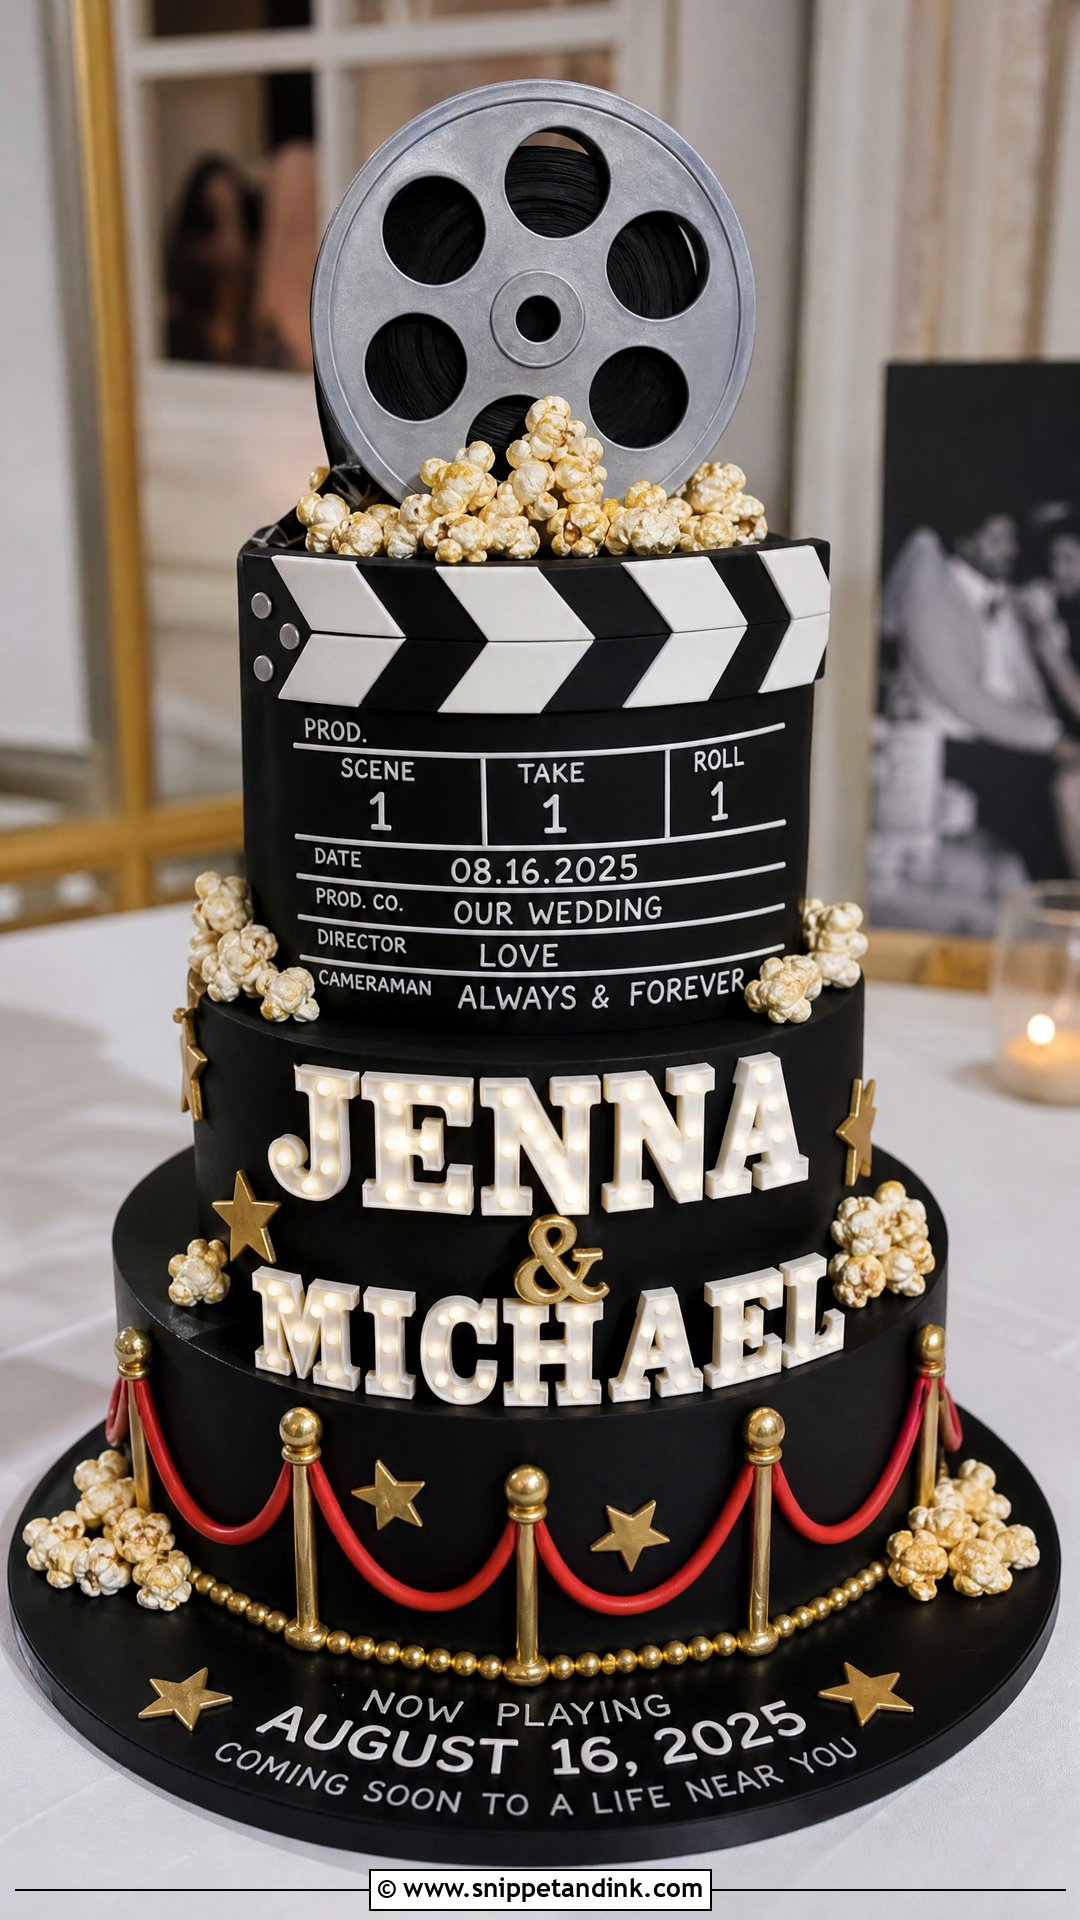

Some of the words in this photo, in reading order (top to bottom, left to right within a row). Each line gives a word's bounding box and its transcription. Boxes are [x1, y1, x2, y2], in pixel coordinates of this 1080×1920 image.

[305, 718, 366, 743] PROD.
[341, 758, 415, 781] SCENE
[518, 762, 584, 783] TAKE
[695, 746, 744, 772] ROLL
[370, 792, 392, 831] 1
[543, 794, 567, 833] 1
[711, 781, 728, 821] 1
[315, 848, 361, 867] DATE
[451, 854, 637, 884] 08.16.2025
[316, 888, 366, 908] PROD.
[373, 894, 403, 911] CO.
[454, 901, 513, 925] OUR
[528, 896, 664, 926] WEDDING
[318, 929, 406, 953] DIRECTOR
[480, 944, 558, 967] LOVE
[319, 970, 431, 995] CAMERAMAN
[458, 985, 576, 1010] ALWAYS
[592, 985, 609, 1009] &
[629, 967, 744, 1006] FOREVER
[267, 1052, 809, 1216] JENNA
[514, 1214, 609, 1305] &
[253, 1253, 845, 1407] MICHAEL
[362, 1690, 464, 1723] NOW
[497, 1694, 670, 1726] PLAYING
[255, 1704, 519, 1776] AUGUST
[552, 1736, 637, 1777] 16,
[653, 1700, 807, 1766] 2025
[215, 1740, 348, 1795] COMING
[363, 1781, 461, 1813] SOON
[482, 1793, 528, 1815] TO
[551, 1794, 573, 1816] A
[593, 1785, 671, 1813] LIFE
[688, 1765, 784, 1802] NEAR
[790, 1737, 857, 1773] YOU
